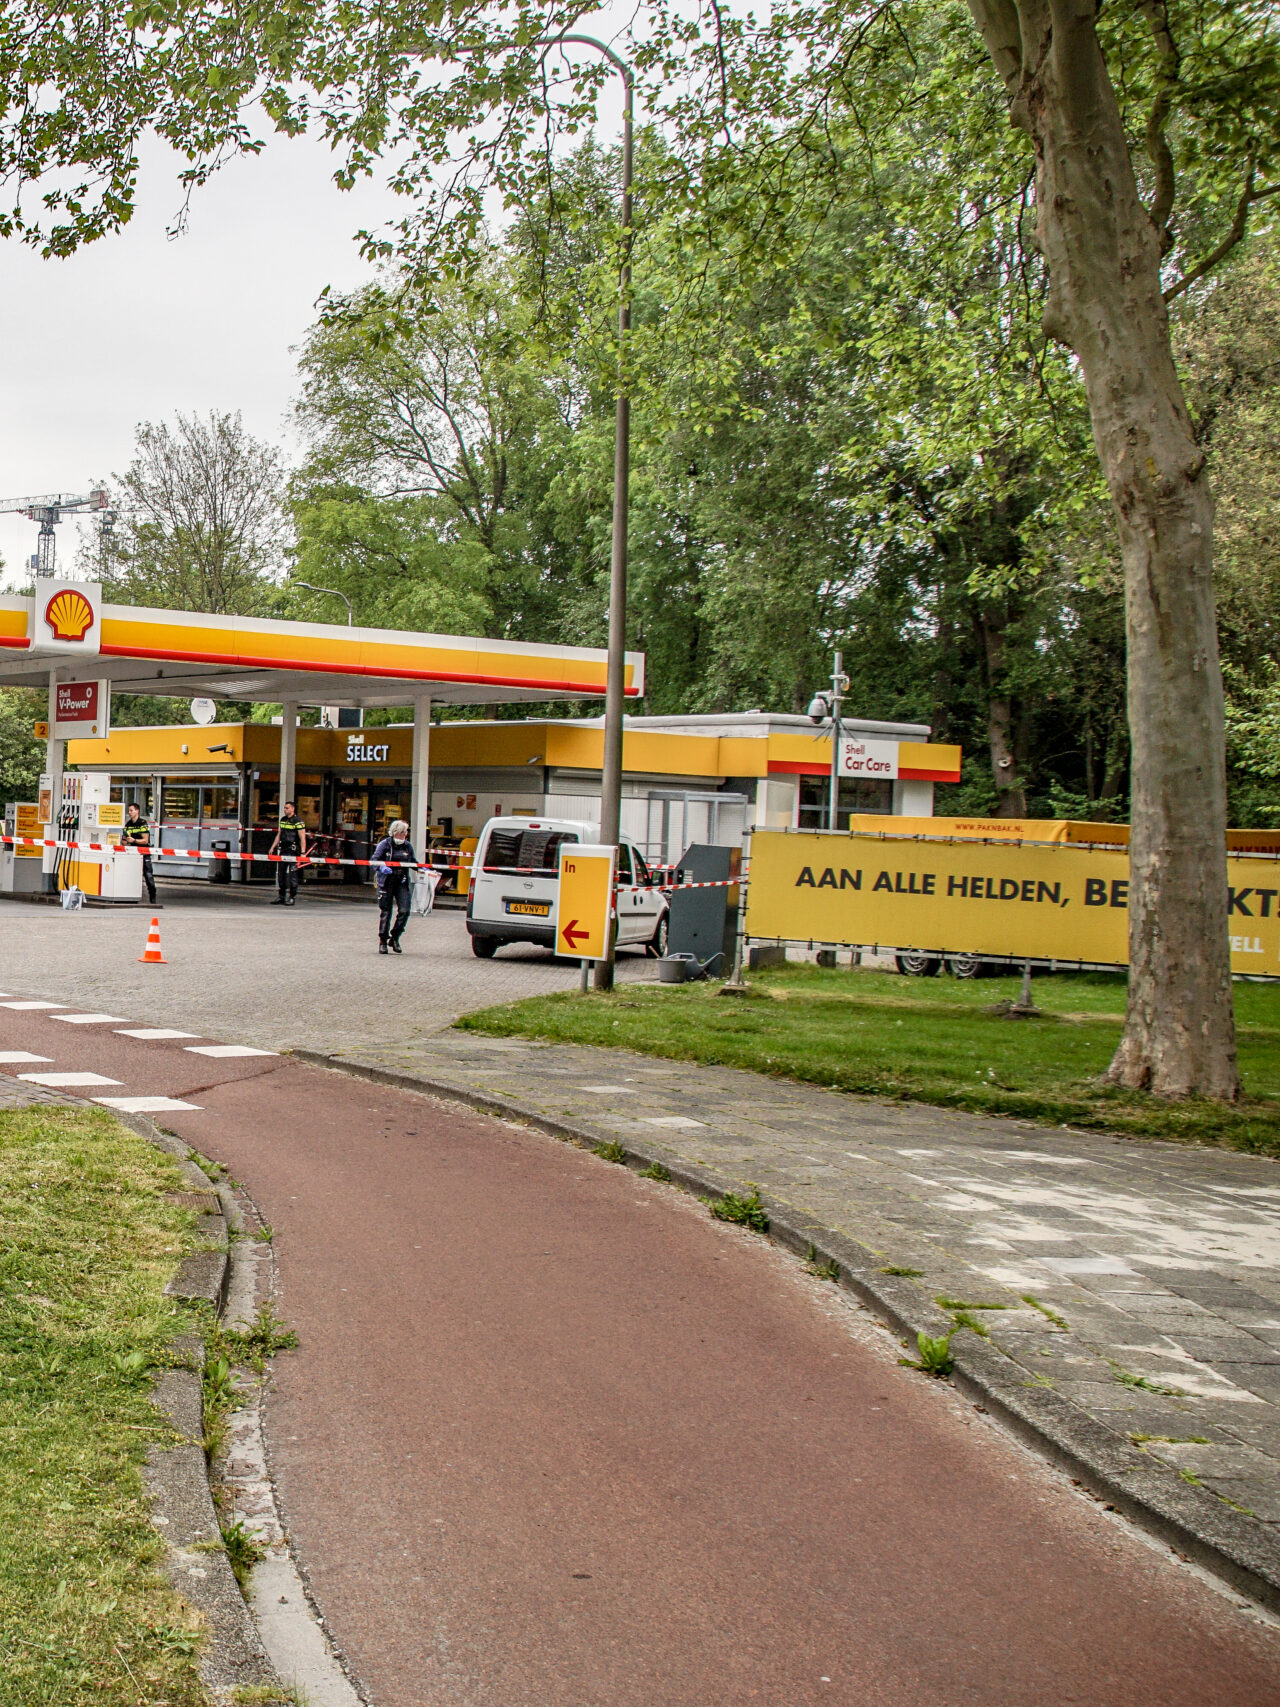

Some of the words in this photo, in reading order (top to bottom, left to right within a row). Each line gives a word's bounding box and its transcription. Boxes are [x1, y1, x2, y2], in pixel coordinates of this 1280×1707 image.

[59, 689, 71, 698] Shell
[59, 699, 90, 710] V-Power
[39, 726, 46, 735] 2
[348, 734, 365, 744] Shell
[347, 745, 389, 762] SELECT
[845, 744, 865, 755] Shell
[845, 756, 864, 770] Car
[866, 758, 891, 772] Care
[564, 860, 575, 873] In
[795, 866, 863, 891] AAN
[872, 870, 937, 896] ALLE
[946, 874, 1070, 908] HELDEN,
[513, 904, 545, 914] 61-VNV-1
